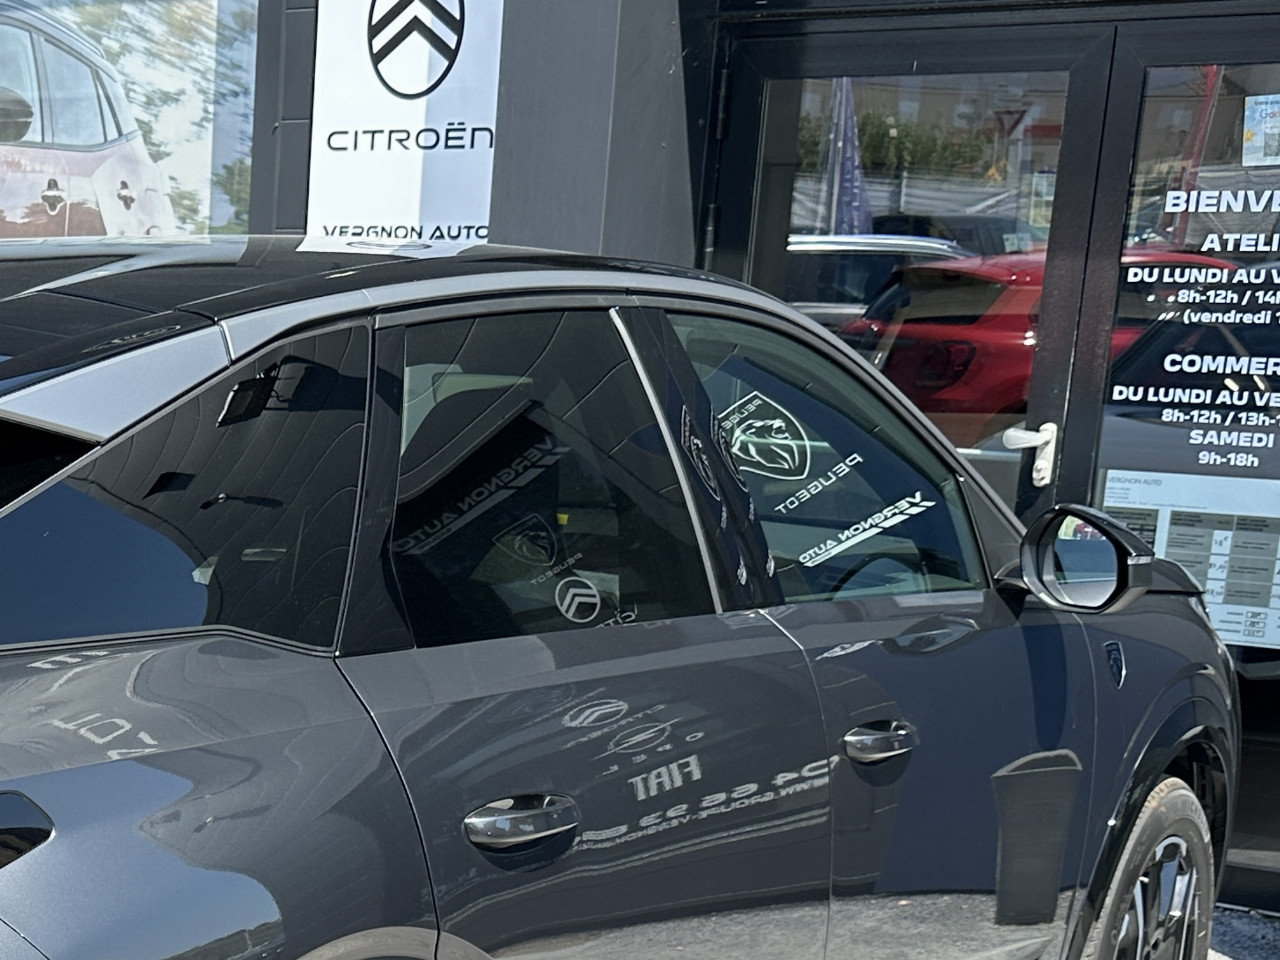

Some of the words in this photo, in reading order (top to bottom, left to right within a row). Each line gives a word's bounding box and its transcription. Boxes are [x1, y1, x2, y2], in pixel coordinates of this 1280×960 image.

[327, 122, 494, 151] CITROËN
[429, 225, 489, 240] AUTO
[1201, 233, 1280, 252] ATELI
[1127, 267, 1159, 283] DU
[1163, 267, 1229, 284] LUNDI
[1232, 268, 1266, 284] AU
[1177, 290, 1238, 304] 8h-12h
[1183, 309, 1272, 324] (vendredi
[1164, 354, 1280, 376] COMMER
[1112, 385, 1144, 401] DU
[1147, 387, 1212, 404] LUNDI
[1215, 390, 1249, 406] AU
[1161, 408, 1222, 424] 8h-12h
[1189, 429, 1275, 447] SAMEDI
[1198, 451, 1259, 467] 9h-18h
